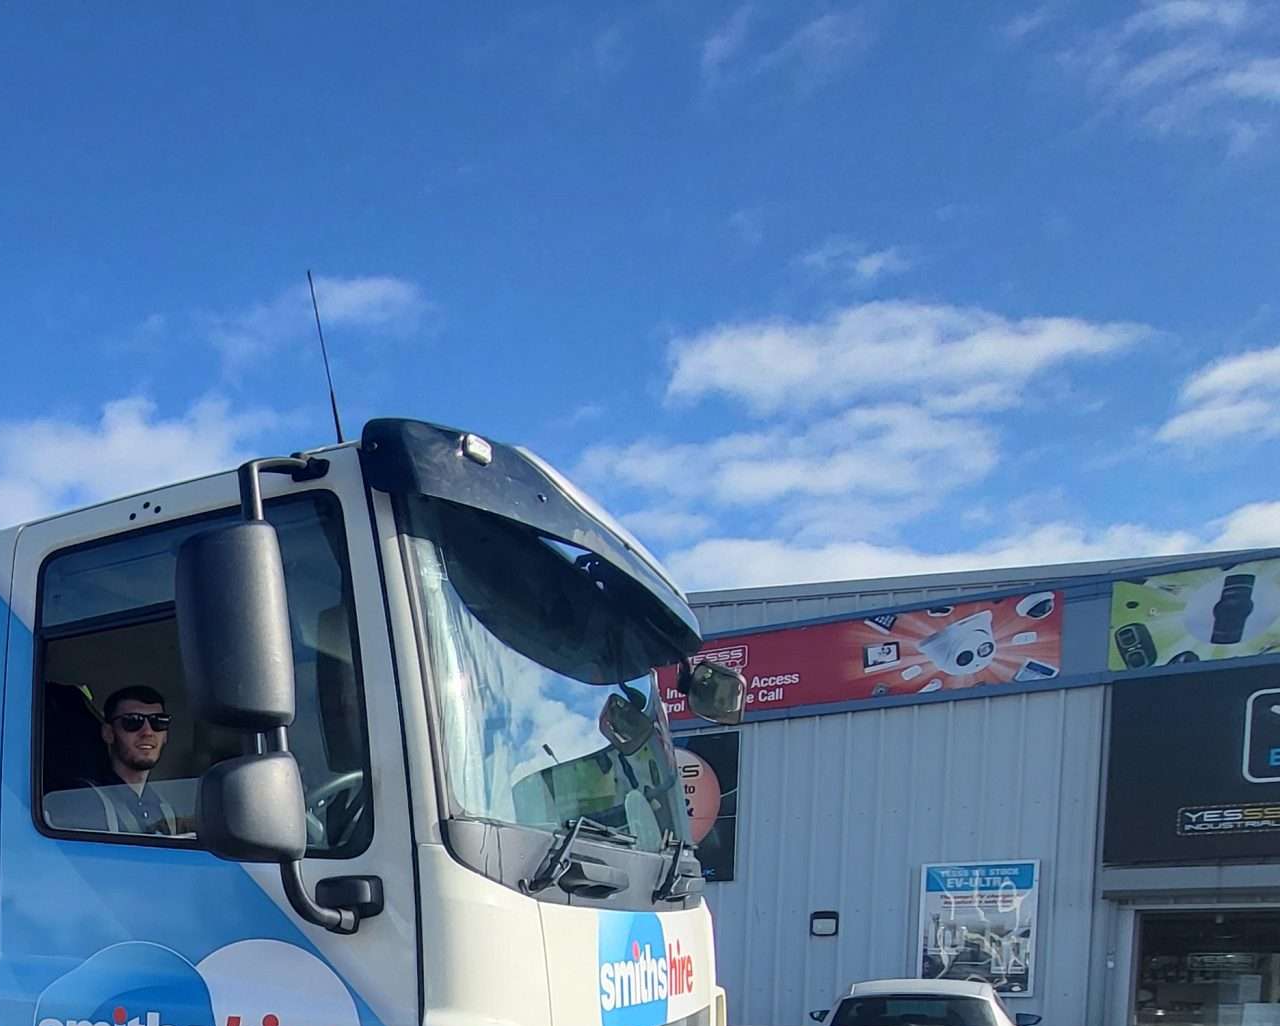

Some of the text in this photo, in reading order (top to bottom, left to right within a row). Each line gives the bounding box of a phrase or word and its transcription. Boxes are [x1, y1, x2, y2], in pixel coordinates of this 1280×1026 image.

[751, 674, 800, 688] Access
[758, 688, 783, 702] Call
[600, 940, 694, 1012] smiths hire
